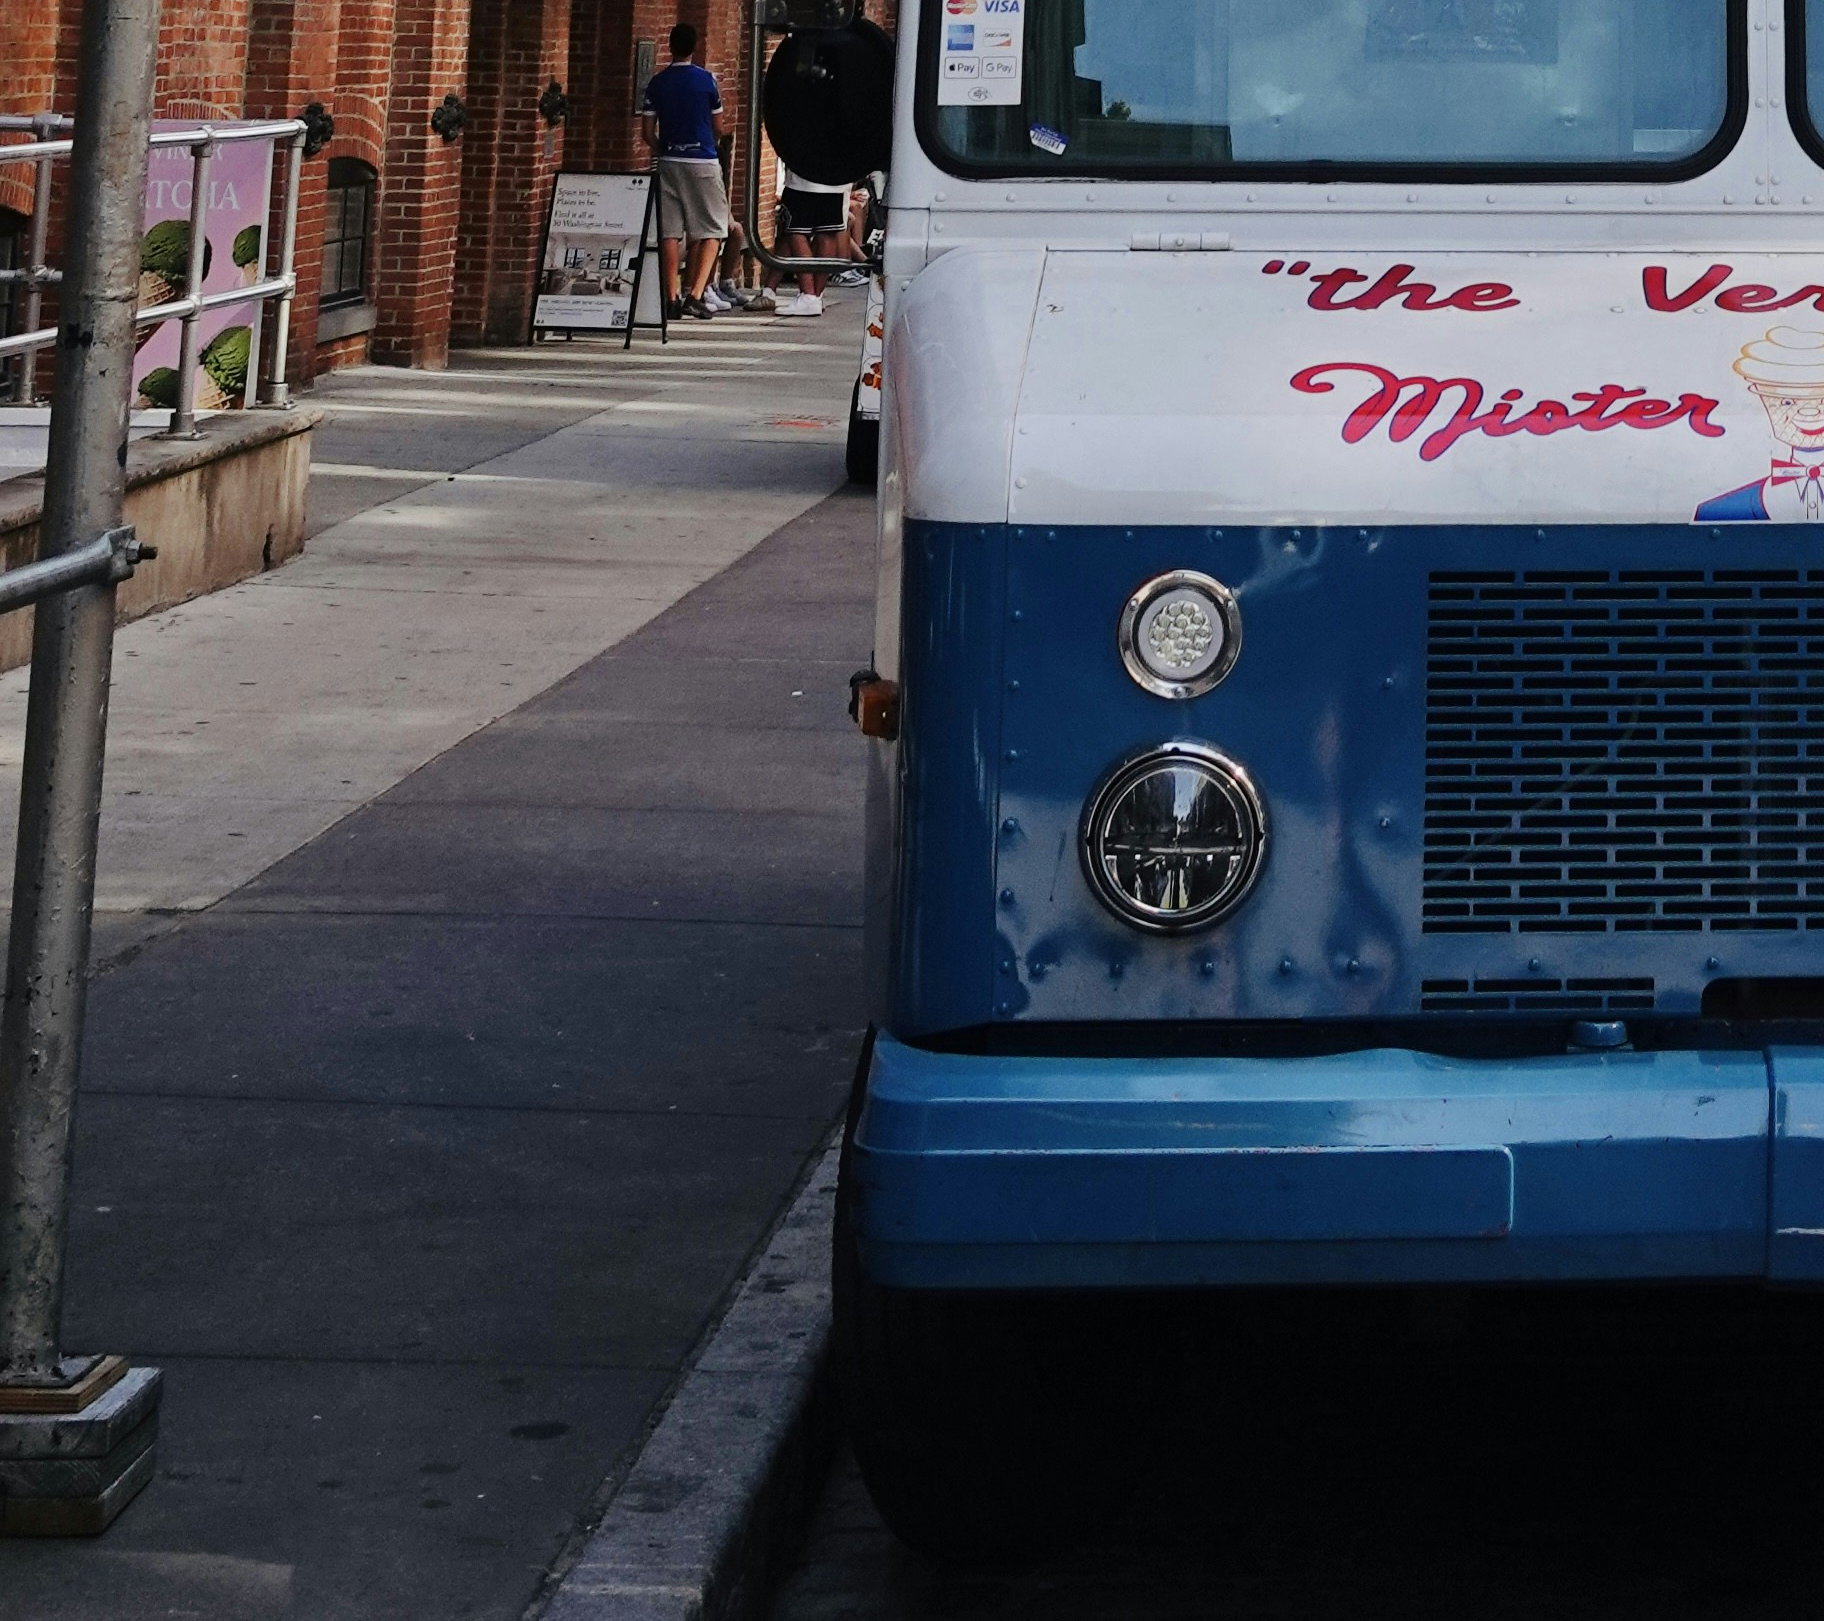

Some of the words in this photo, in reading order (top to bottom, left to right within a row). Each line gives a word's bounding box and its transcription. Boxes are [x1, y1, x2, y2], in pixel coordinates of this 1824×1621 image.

[984, 0, 1020, 13] VISA
[957, 62, 974, 73] Pay
[997, 62, 1012, 73] Pay
[1261, 260, 1521, 313] "the
[1289, 361, 1727, 463] Mister
